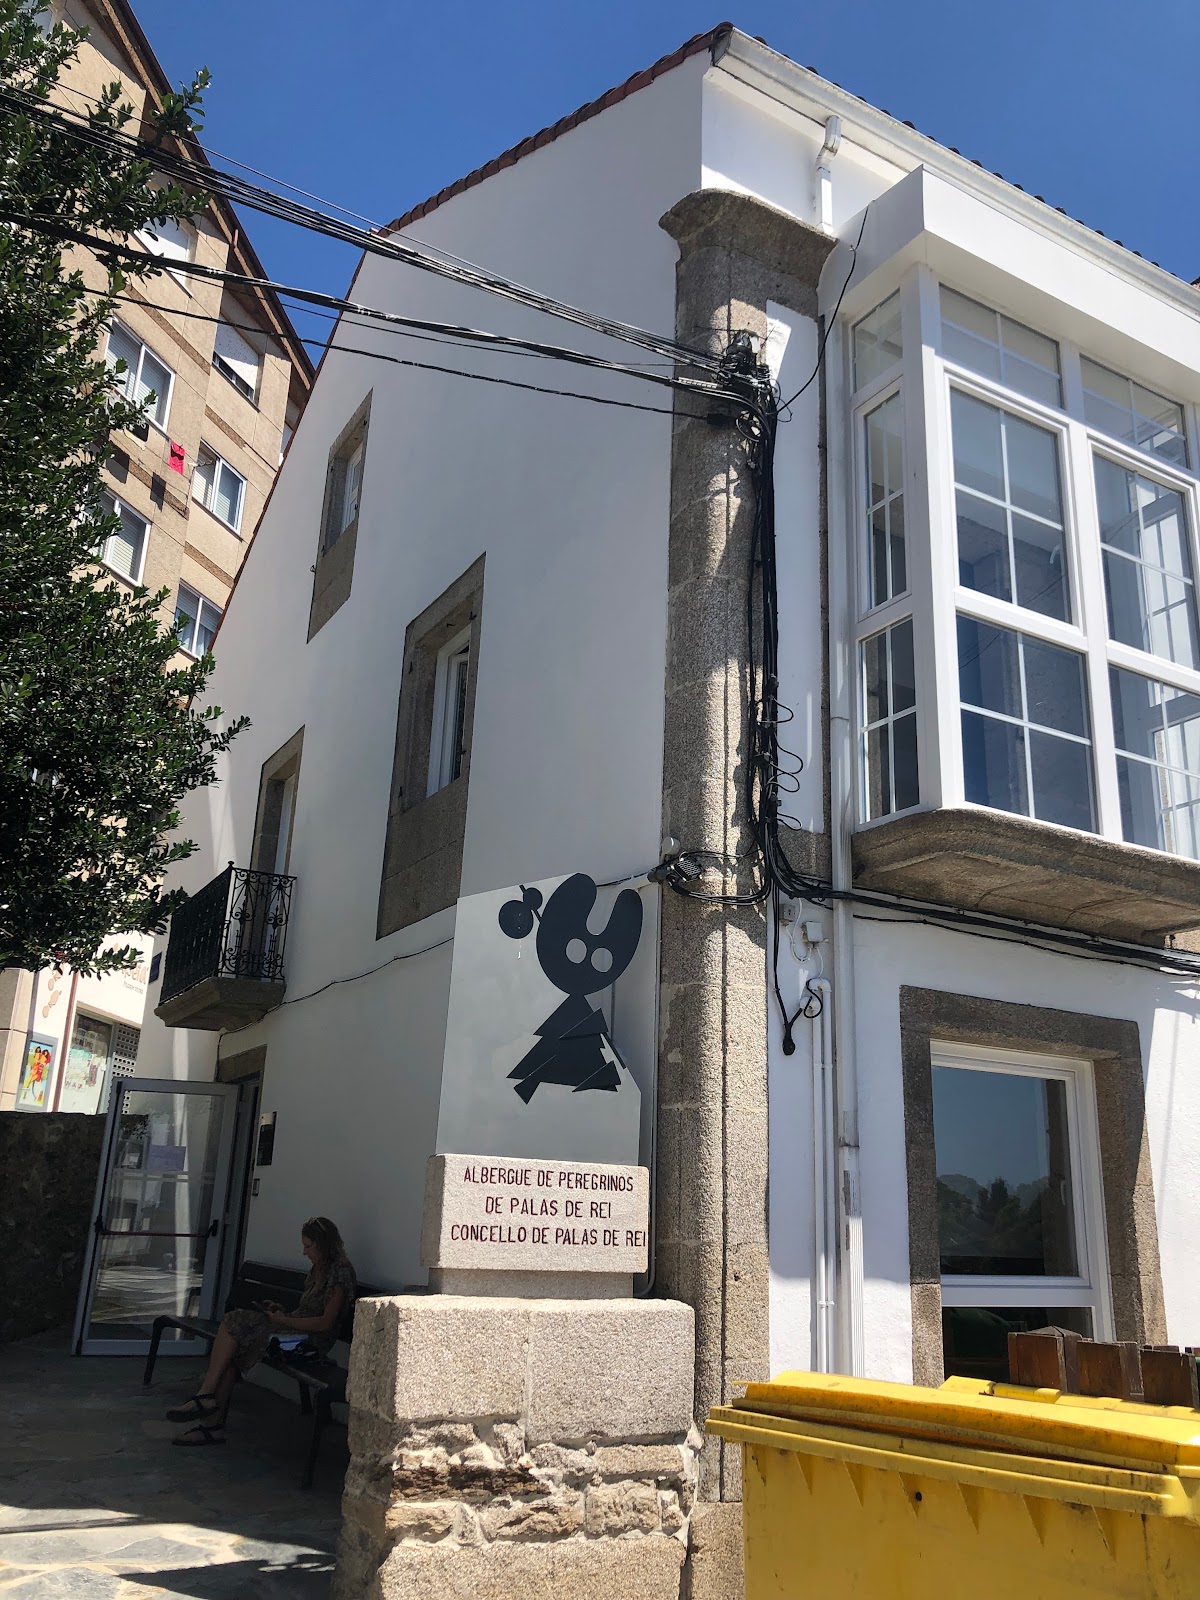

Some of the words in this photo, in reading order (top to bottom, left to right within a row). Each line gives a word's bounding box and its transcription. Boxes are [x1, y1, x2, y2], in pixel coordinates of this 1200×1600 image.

[464, 1166, 532, 1186] ALBERGUE
[537, 1170, 554, 1187] DE
[558, 1171, 634, 1192] PEREGRINOS
[485, 1196, 504, 1214] DE
[510, 1197, 558, 1216] PALAS
[565, 1200, 584, 1218] DE
[590, 1201, 611, 1219] REI
[451, 1224, 527, 1243] CONCELLO
[532, 1227, 550, 1244] DE
[555, 1228, 598, 1246] PALAS
[603, 1229, 620, 1247] DE
[626, 1230, 646, 1247] REI
